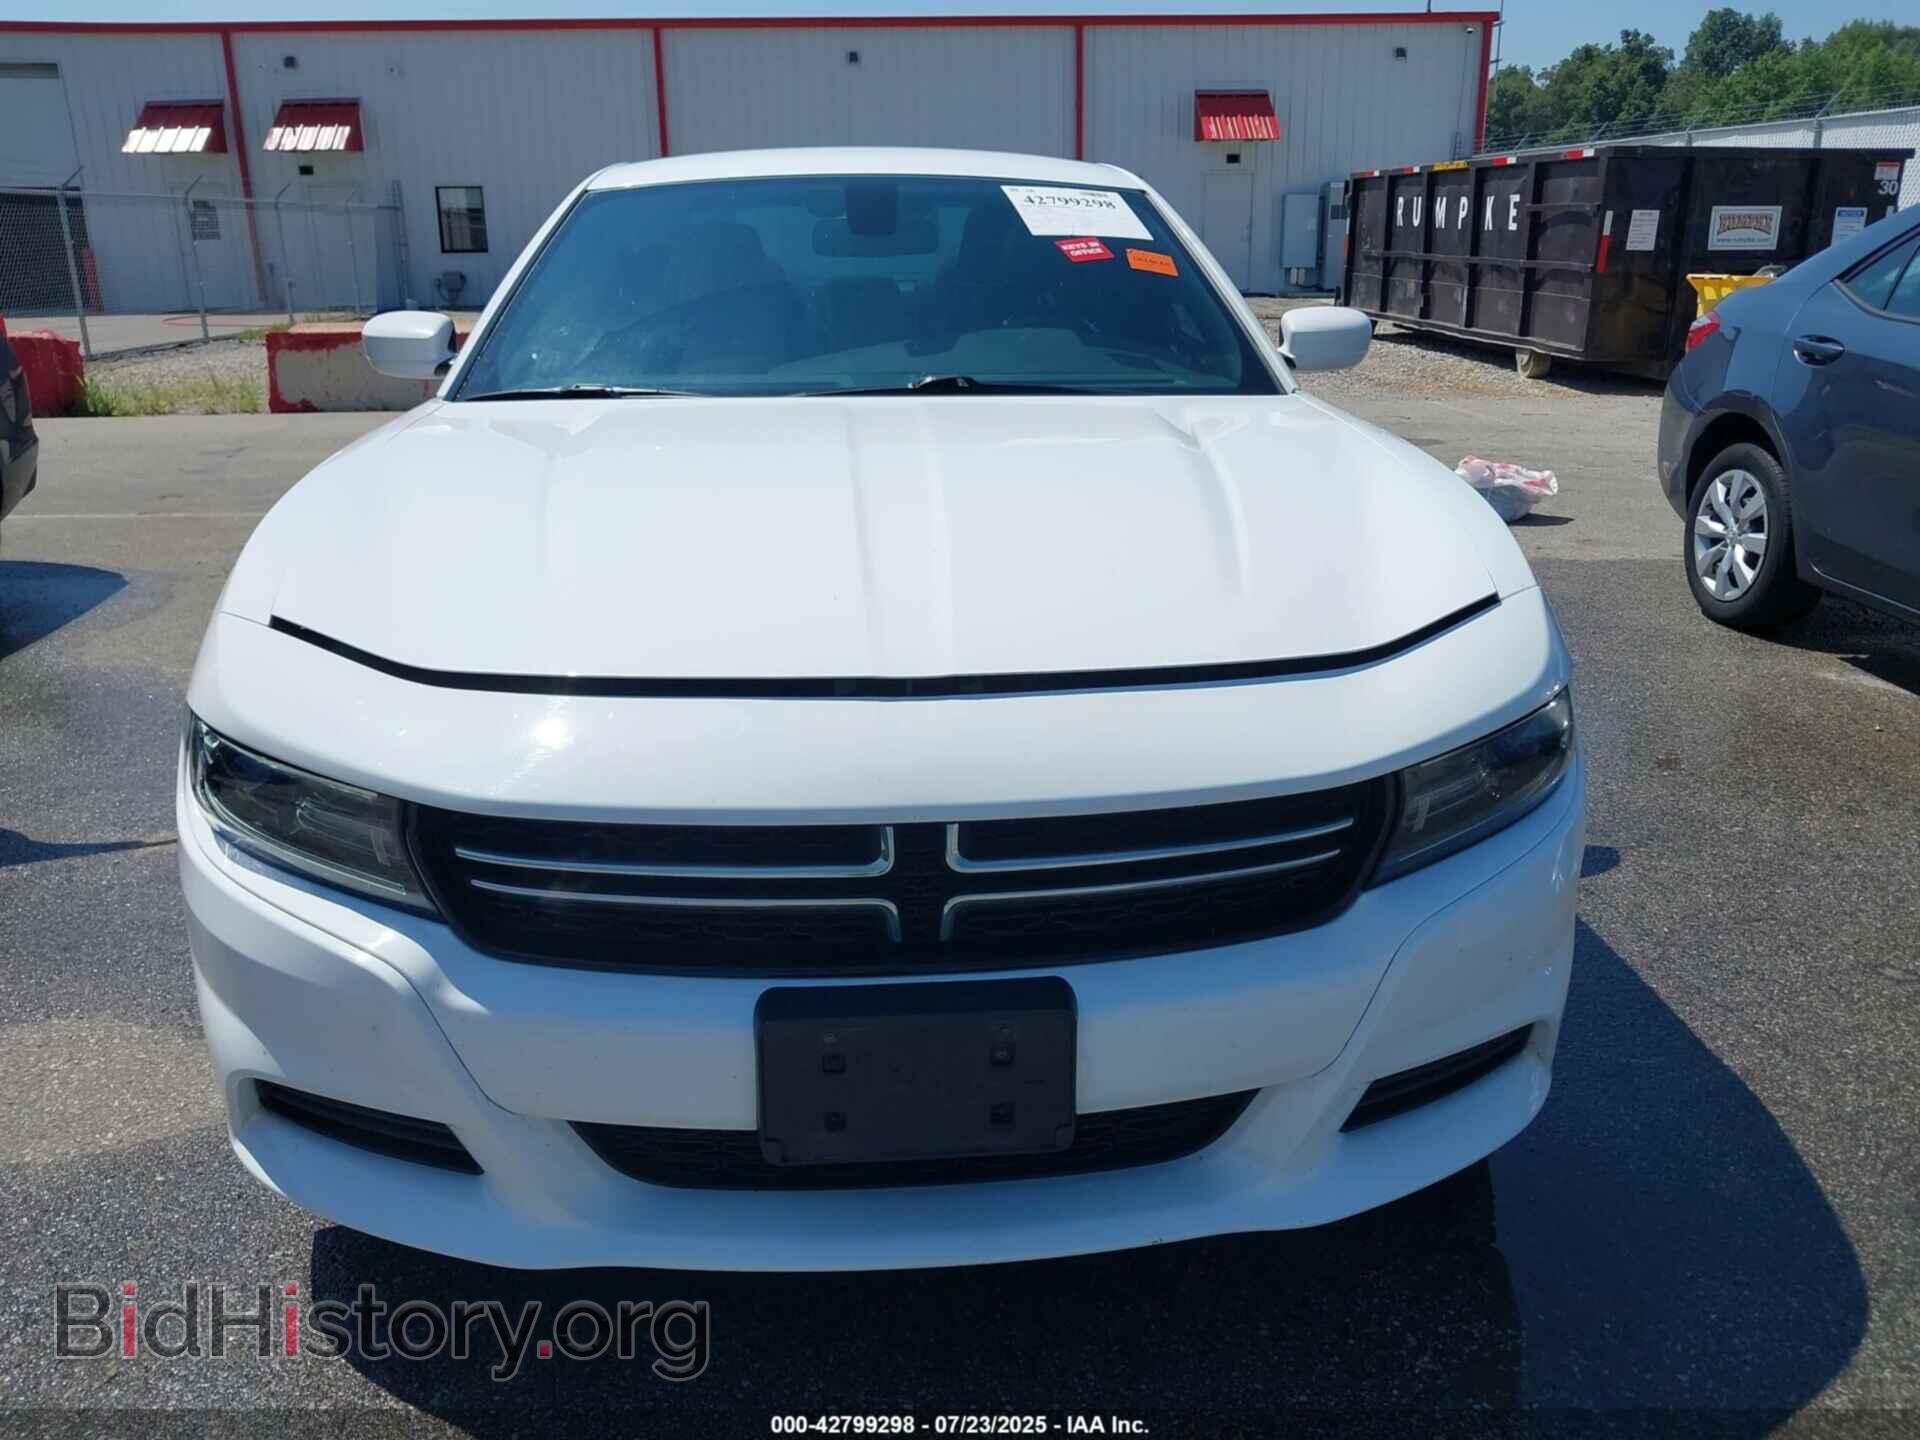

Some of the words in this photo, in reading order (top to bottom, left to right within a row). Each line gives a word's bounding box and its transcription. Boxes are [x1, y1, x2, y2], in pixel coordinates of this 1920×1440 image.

[1878, 180, 1899, 196] 30
[1024, 194, 1117, 209] 42799298
[1396, 193, 1521, 231] RUMPKE
[1069, 247, 1105, 257] OFFICE
